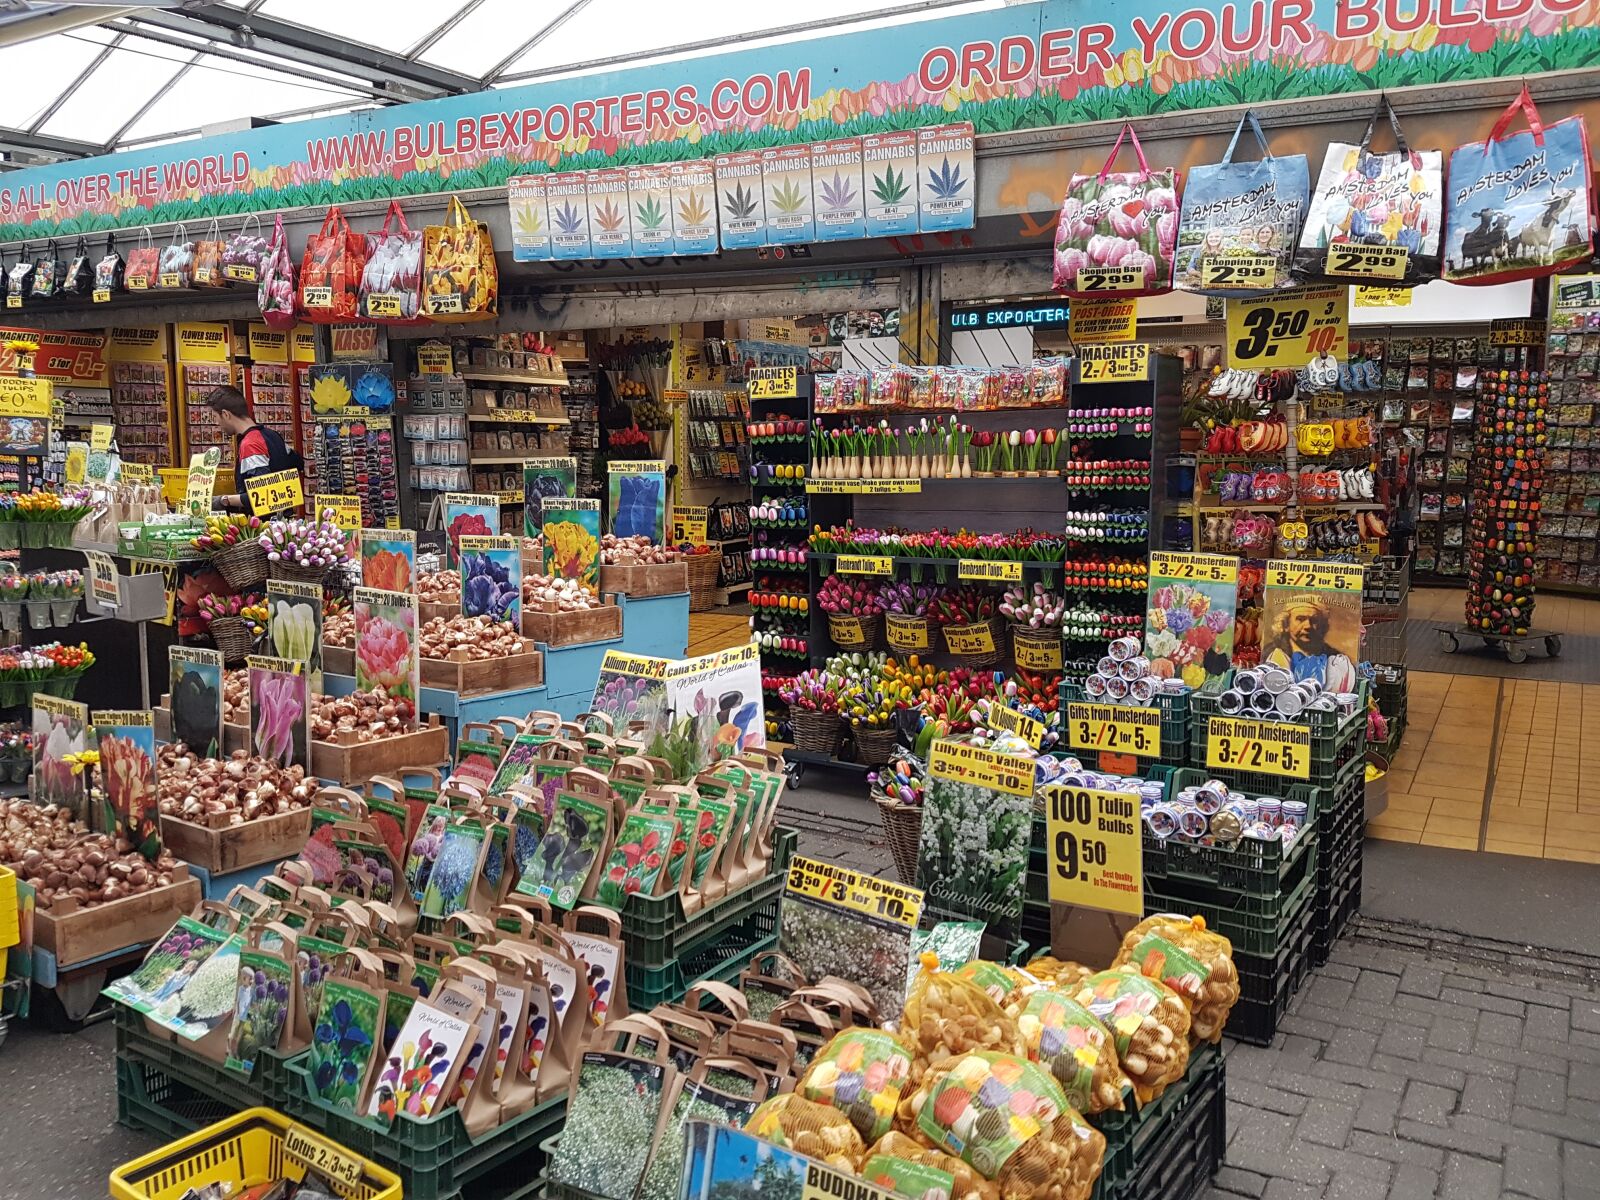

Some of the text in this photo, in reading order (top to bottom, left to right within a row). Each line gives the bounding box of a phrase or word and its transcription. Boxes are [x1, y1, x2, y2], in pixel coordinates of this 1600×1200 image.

[919, 0, 1575, 93] ORDER YOUR BUL
[307, 67, 811, 174] WWW.BULBEXPORTERS.COM
[864, 145, 915, 162] CANNABIS
[919, 138, 972, 155] CANNABIS
[763, 157, 809, 173] CANNABIS
[812, 152, 861, 167] CANNABIS
[716, 164, 760, 179] CANNABIS
[1456, 151, 1545, 204] AMSTERDAM
[16, 151, 250, 213] ALL OVER THE WORLD
[587, 181, 626, 194] CANNABIS
[1505, 165, 1575, 202] LOVES YOU
[547, 184, 585, 197] CANNABIS
[1366, 184, 1434, 210] LOVES YOU
[1191, 180, 1277, 219] AMSTERDAM
[1142, 206, 1166, 227] YOU
[1239, 196, 1301, 223] LOVES YOU
[1331, 244, 1407, 257] Shopping Bag
[1206, 258, 1276, 267] Shopping Bag
[1334, 254, 1397, 273] 2.99
[1079, 267, 1121, 275] Shopping
[1209, 266, 1266, 283] 2.99
[1084, 275, 1135, 290] 2.99
[306, 293, 327, 305] 2.99
[1305, 290, 1344, 300] SELFSERVICE
[371, 300, 396, 313] 2.99
[431, 301, 457, 314] 2.99
[1074, 305, 1134, 319] POST-ORDER
[1324, 301, 1335, 316] 3
[1313, 316, 1342, 326] for only
[112, 328, 159, 339] FLOWER SEEDS
[181, 330, 222, 340] FLOWER SEEDS
[251, 332, 285, 342] FLOWER SEEDS
[1235, 307, 1310, 360] 3.50
[43, 335, 66, 344] MEMO
[70, 337, 102, 347] HOLDERS
[1082, 345, 1146, 361] MAGNETS
[49, 358, 70, 368] 3 for
[1118, 359, 1144, 373] for 5.-
[751, 368, 794, 380] MAGNETS
[126, 464, 143, 475] Tulips
[556, 459, 569, 468] Bulbs
[643, 463, 657, 472] Bulbs
[246, 470, 299, 490] Rembrandt Tulips
[268, 500, 293, 511] Selfservice
[317, 496, 359, 507] Ceramic Shoes
[578, 500, 591, 509] Bulbs
[489, 538, 511, 549] 20 Bulbs
[838, 557, 875, 571] Rembrandt Tulips
[1152, 553, 1236, 567] Gifts from Amsterdam
[959, 561, 1002, 577] Rembrandt Tulips
[1211, 567, 1227, 580] 5.-
[1268, 562, 1363, 576] Gifts from Amsterdam
[1335, 575, 1352, 589] 5.-
[300, 585, 313, 597] Bulbs
[384, 594, 406, 606] 20 Bulbs
[1317, 596, 1356, 610] Collection
[944, 626, 988, 636] Rembrandt Tulips
[604, 656, 644, 675] Allium Giga
[677, 662, 747, 688] World of Callas
[1070, 706, 1160, 726] Gifts from Amsterdam
[1120, 727, 1151, 750] for 5.-
[1210, 719, 1309, 745] Gifts from Amsterdam
[934, 743, 958, 757] Lilly
[961, 748, 971, 758] of
[975, 752, 993, 763] the
[996, 754, 1033, 772] Valley
[1265, 746, 1300, 771] for 5.-
[969, 770, 975, 778] 3
[978, 773, 993, 781] for
[1048, 789, 1133, 825] 100 Tulip
[1098, 818, 1134, 835] Bulbs
[1056, 831, 1107, 881] 9.50
[793, 857, 921, 904] Wedding Flowers
[1103, 870, 1133, 882] Best Quality
[1107, 880, 1138, 893] Flowermarket
[929, 880, 1020, 918] Convallaria
[852, 892, 870, 905] for
[876, 896, 914, 922] 10.-
[570, 939, 590, 950] World
[419, 1012, 462, 1031] World Callas
[286, 1132, 317, 1160] Lotus
